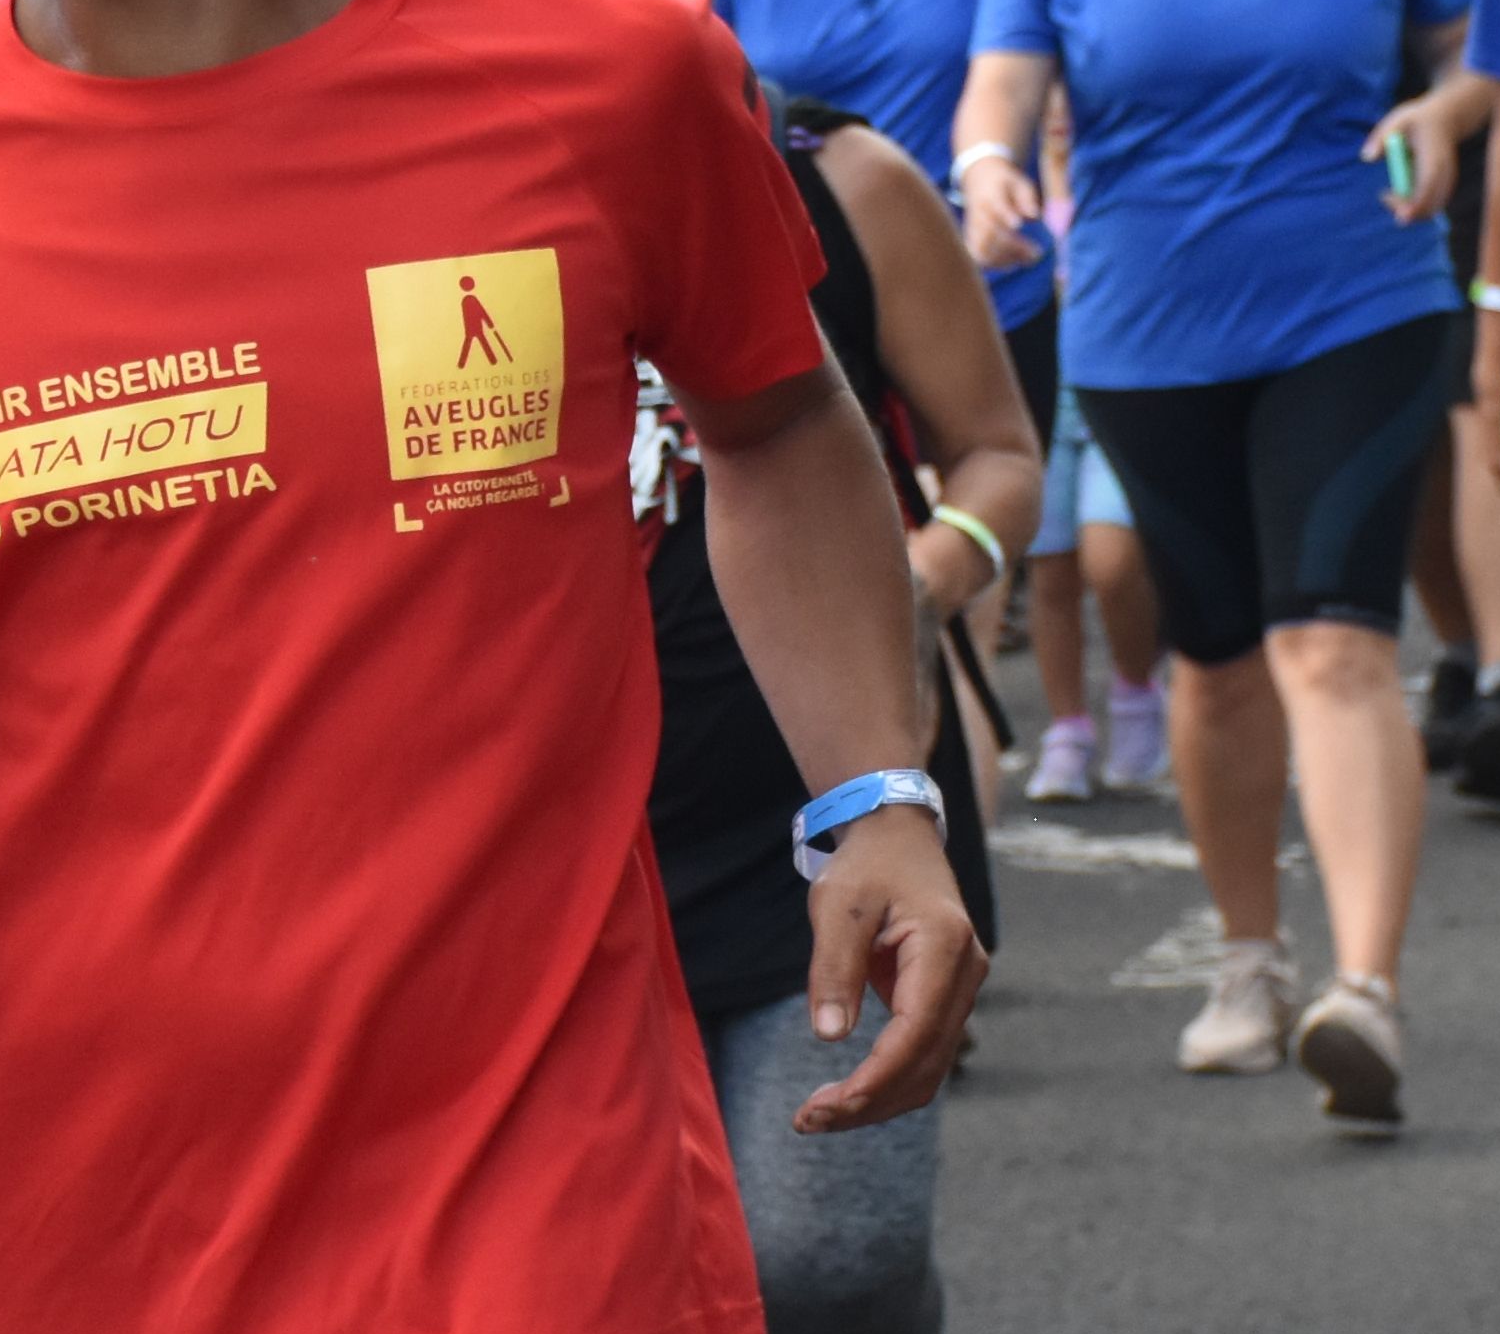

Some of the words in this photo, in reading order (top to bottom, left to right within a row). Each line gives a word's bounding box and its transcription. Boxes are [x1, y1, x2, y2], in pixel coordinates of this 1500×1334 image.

[38, 342, 261, 412] ENSEMBLE
[522, 369, 550, 386] DES
[403, 389, 550, 429] AVEUGLES
[100, 404, 243, 461] HOTU
[405, 433, 443, 459] DE
[453, 418, 547, 453] FRANCE
[11, 463, 276, 537] PORINETIA
[426, 498, 446, 514] ÇA
[446, 494, 483, 511] NOUS
[486, 484, 539, 504] REGARDE
[433, 482, 451, 496] LA
